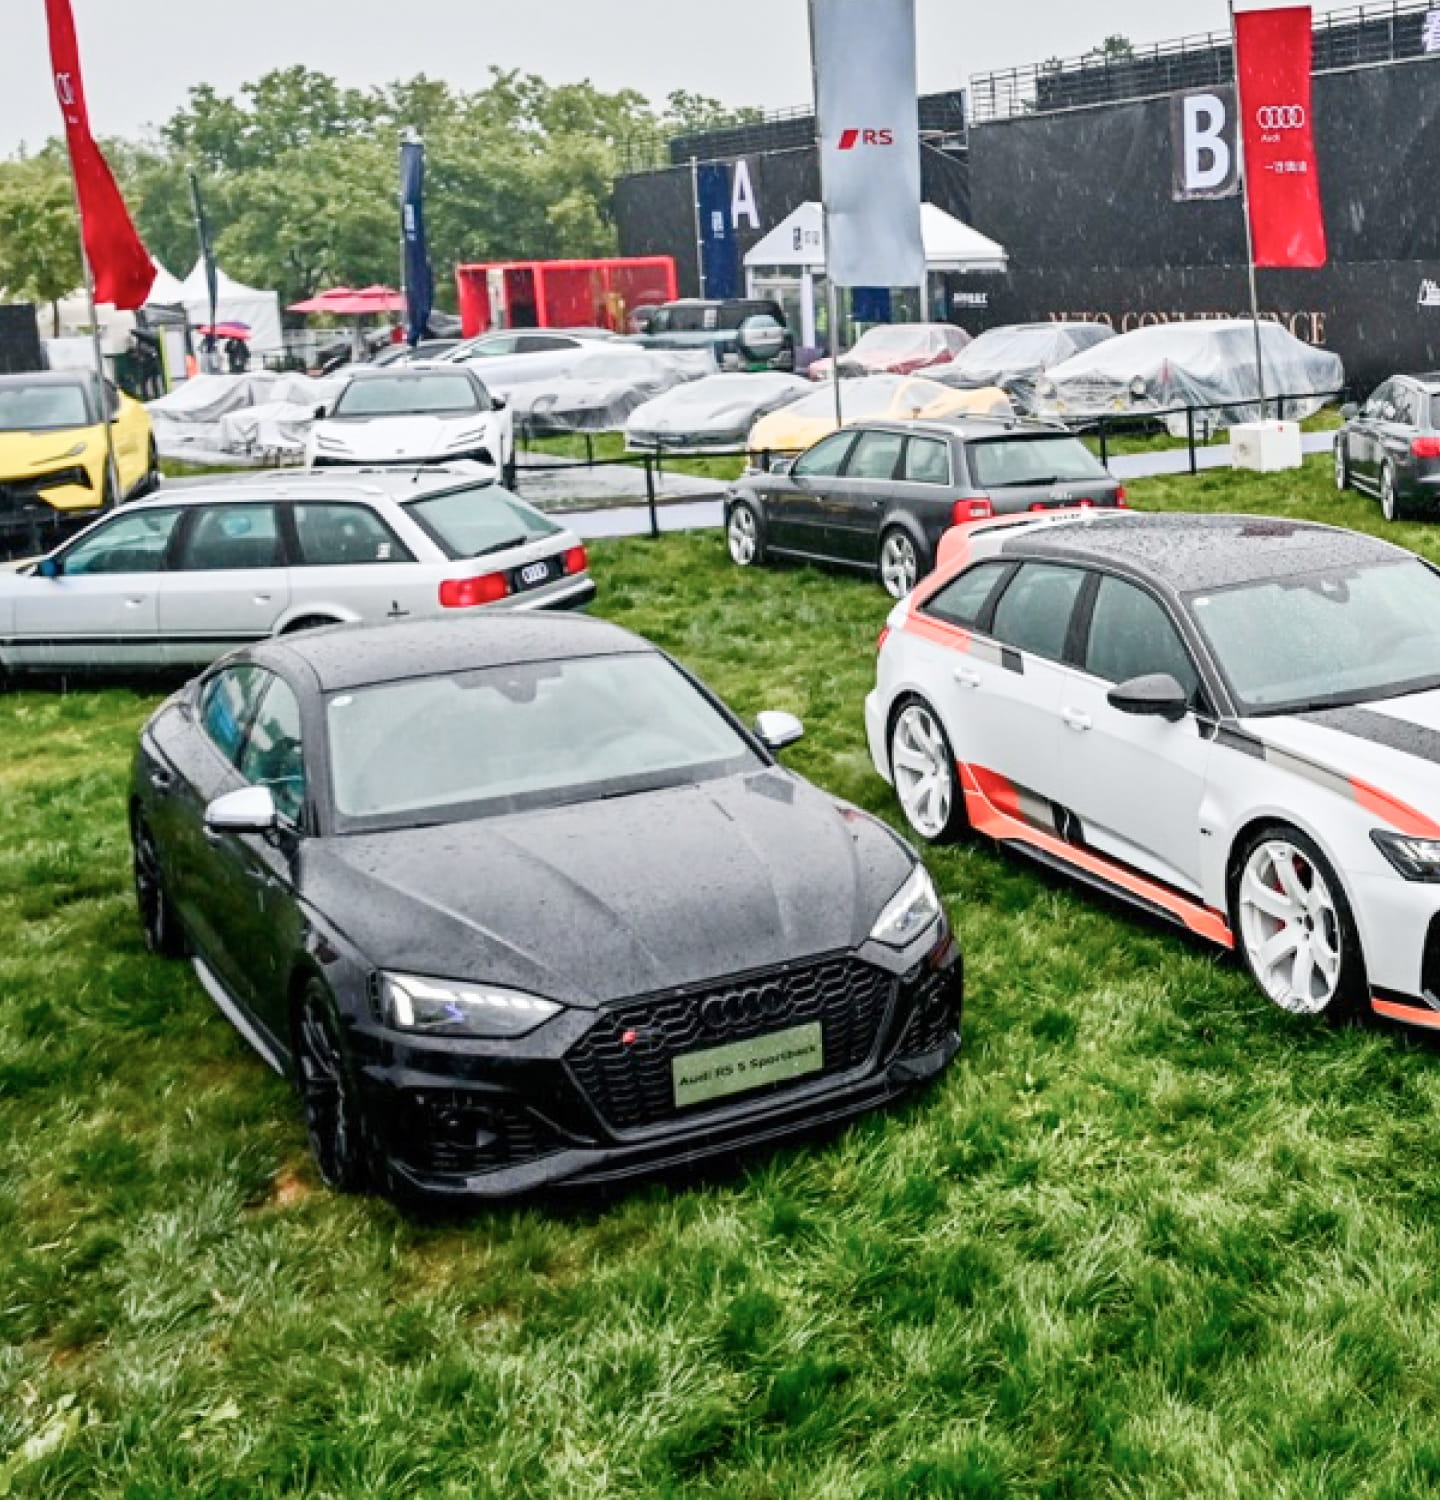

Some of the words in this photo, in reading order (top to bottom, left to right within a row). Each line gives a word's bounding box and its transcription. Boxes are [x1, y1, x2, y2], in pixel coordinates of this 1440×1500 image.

[862, 128, 893, 145] RS
[1183, 94, 1230, 188] B
[731, 160, 761, 230] A
[679, 1070, 712, 1086] Audi
[716, 1065, 734, 1078] RS
[749, 1043, 817, 1070] Sportback
